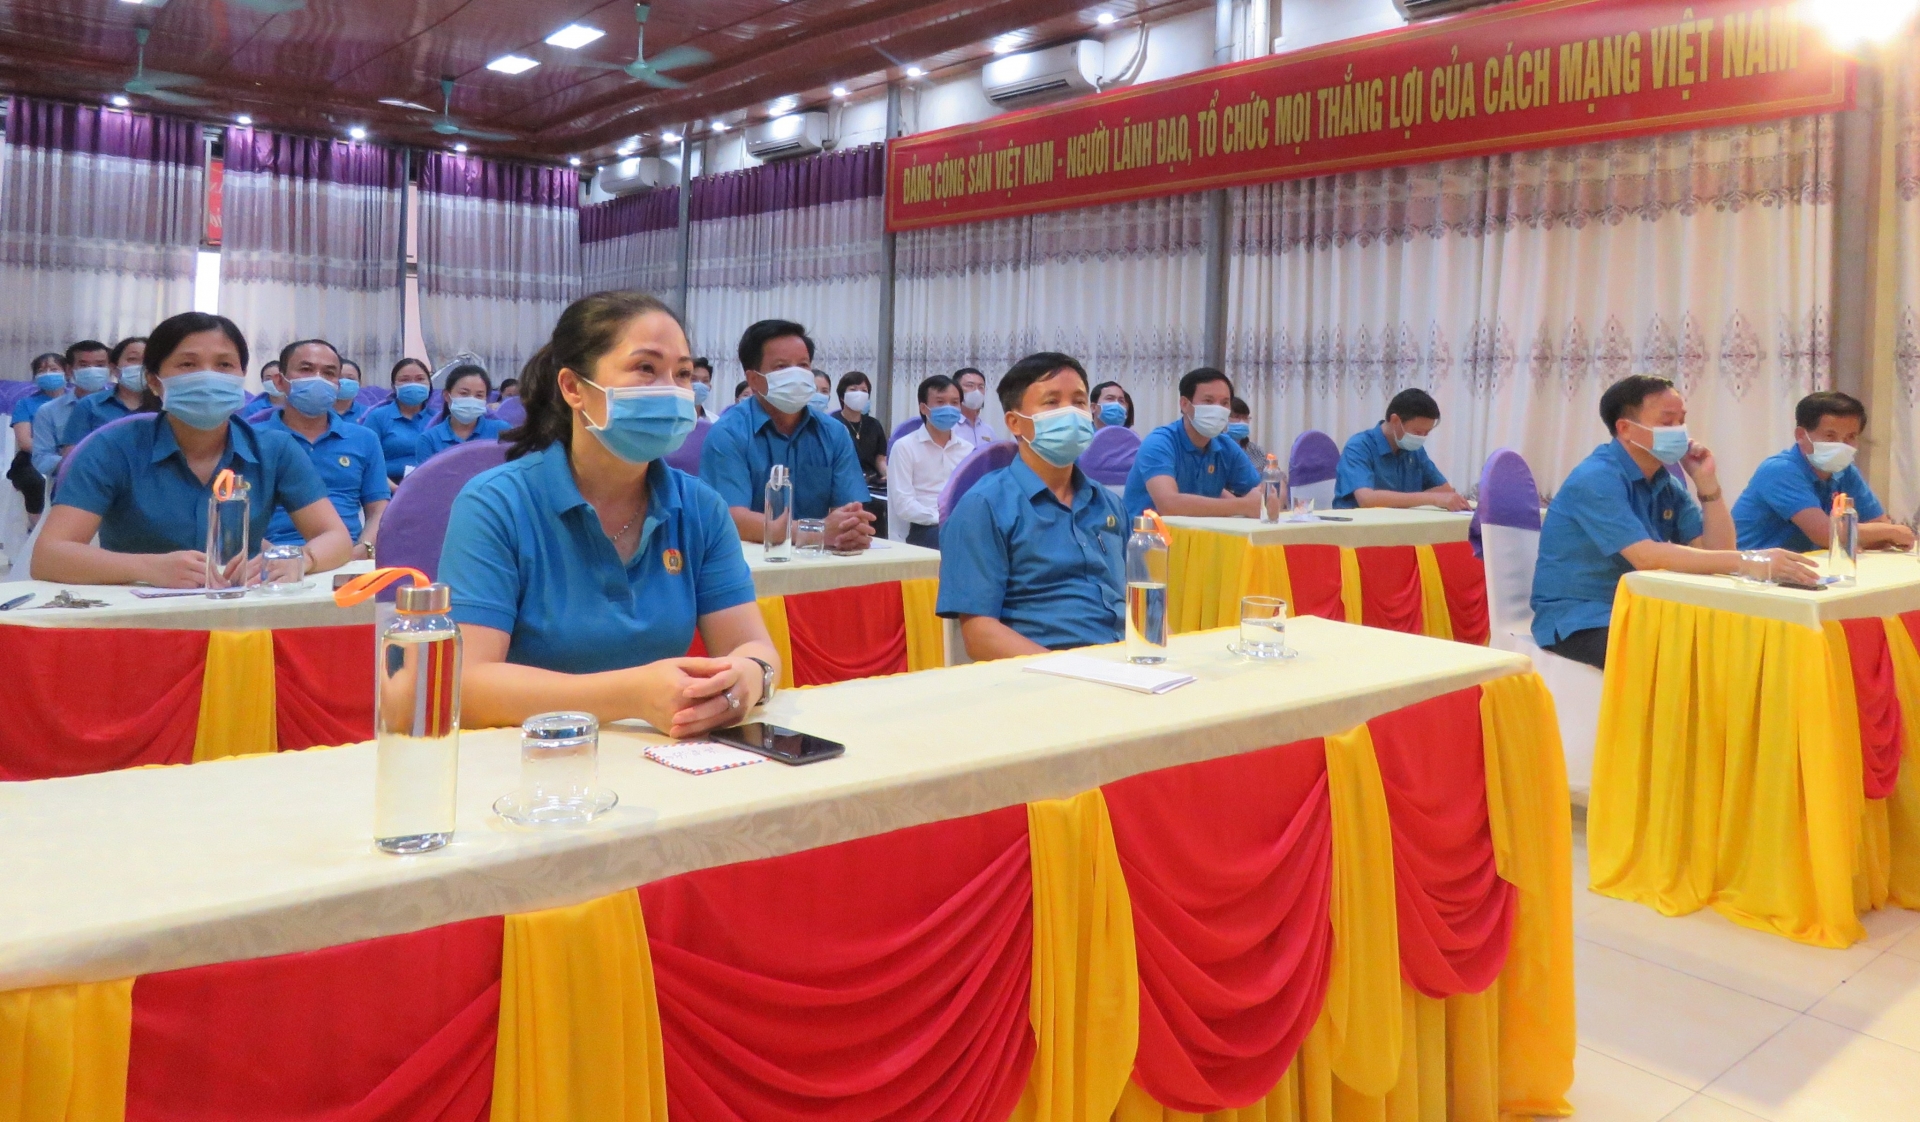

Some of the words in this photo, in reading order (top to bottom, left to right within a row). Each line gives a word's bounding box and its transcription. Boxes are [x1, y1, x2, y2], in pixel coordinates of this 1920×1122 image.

[903, 154, 932, 205] ĐẢNG
[934, 152, 965, 208] CỘNG
[968, 141, 992, 195] SẢN
[995, 139, 1021, 198] VIỆT
[1023, 140, 1055, 186] NAM
[1066, 120, 1110, 179] NGƯỜI
[1113, 117, 1153, 172] LÃNH
[1156, 114, 1192, 173] ĐẠO,
[1198, 89, 1220, 158] TỔ
[1222, 90, 1269, 154] CHỨC
[1274, 91, 1312, 155] MỌI
[1317, 63, 1383, 140] THẮNG
[1389, 66, 1424, 139] LỢI
[1429, 45, 1476, 123] CỦA
[1483, 41, 1551, 115] CÁCH
[1558, 31, 1642, 113] MẠNG
[1650, 7, 1714, 100] VIỆT
[1722, 2, 1798, 79] NAM
